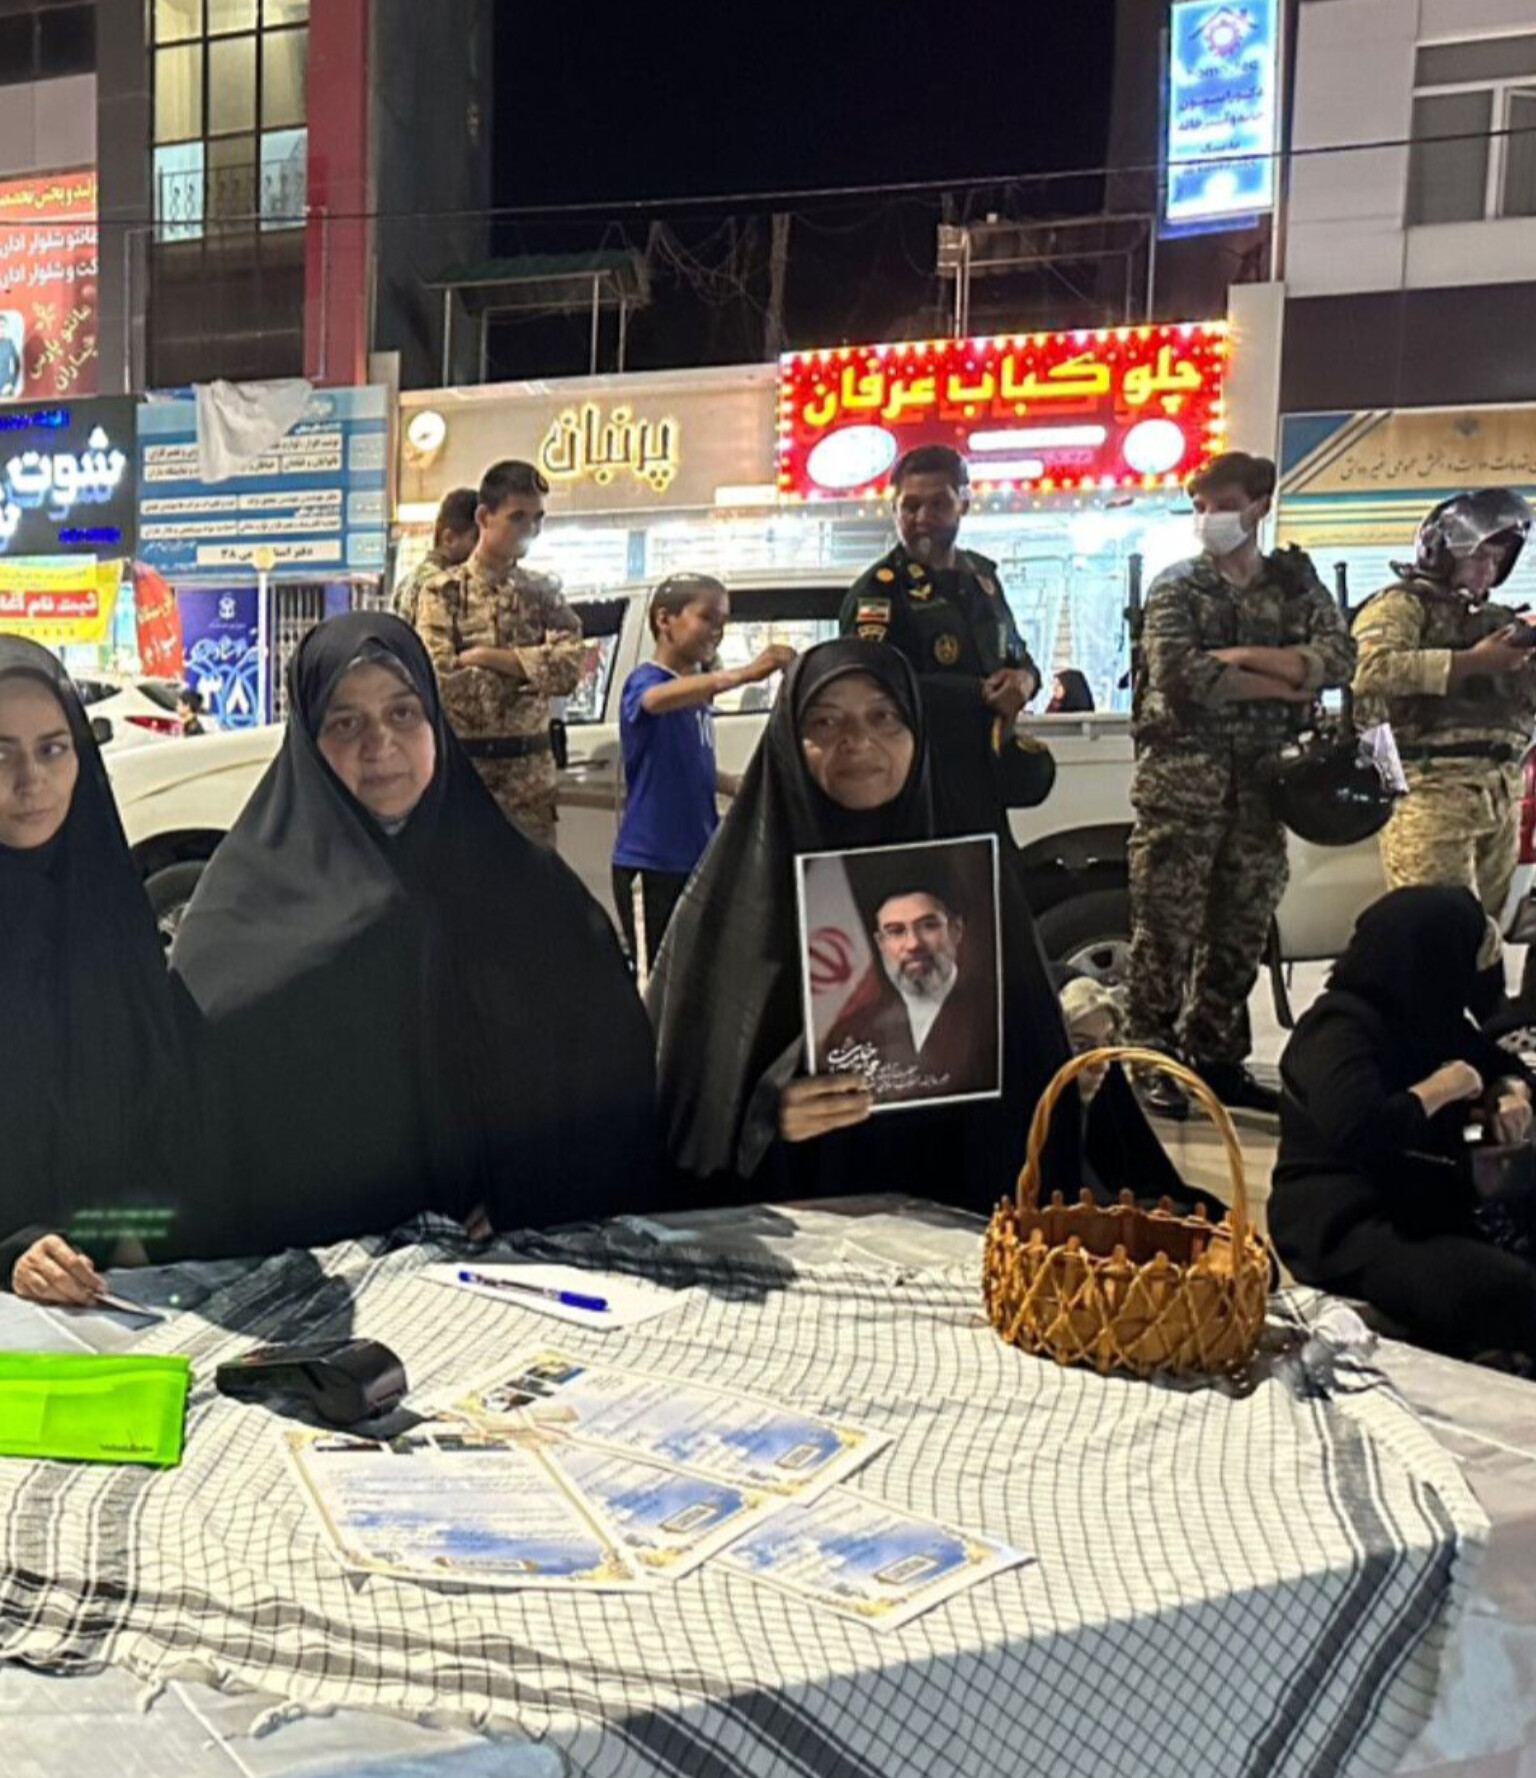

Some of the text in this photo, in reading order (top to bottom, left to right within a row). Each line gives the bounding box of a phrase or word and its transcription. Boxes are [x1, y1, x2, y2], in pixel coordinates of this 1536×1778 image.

[802, 345, 1202, 426] چلو کباب عرفان
[26, 595, 56, 617] نام
[56, 591, 98, 616] ثبت
